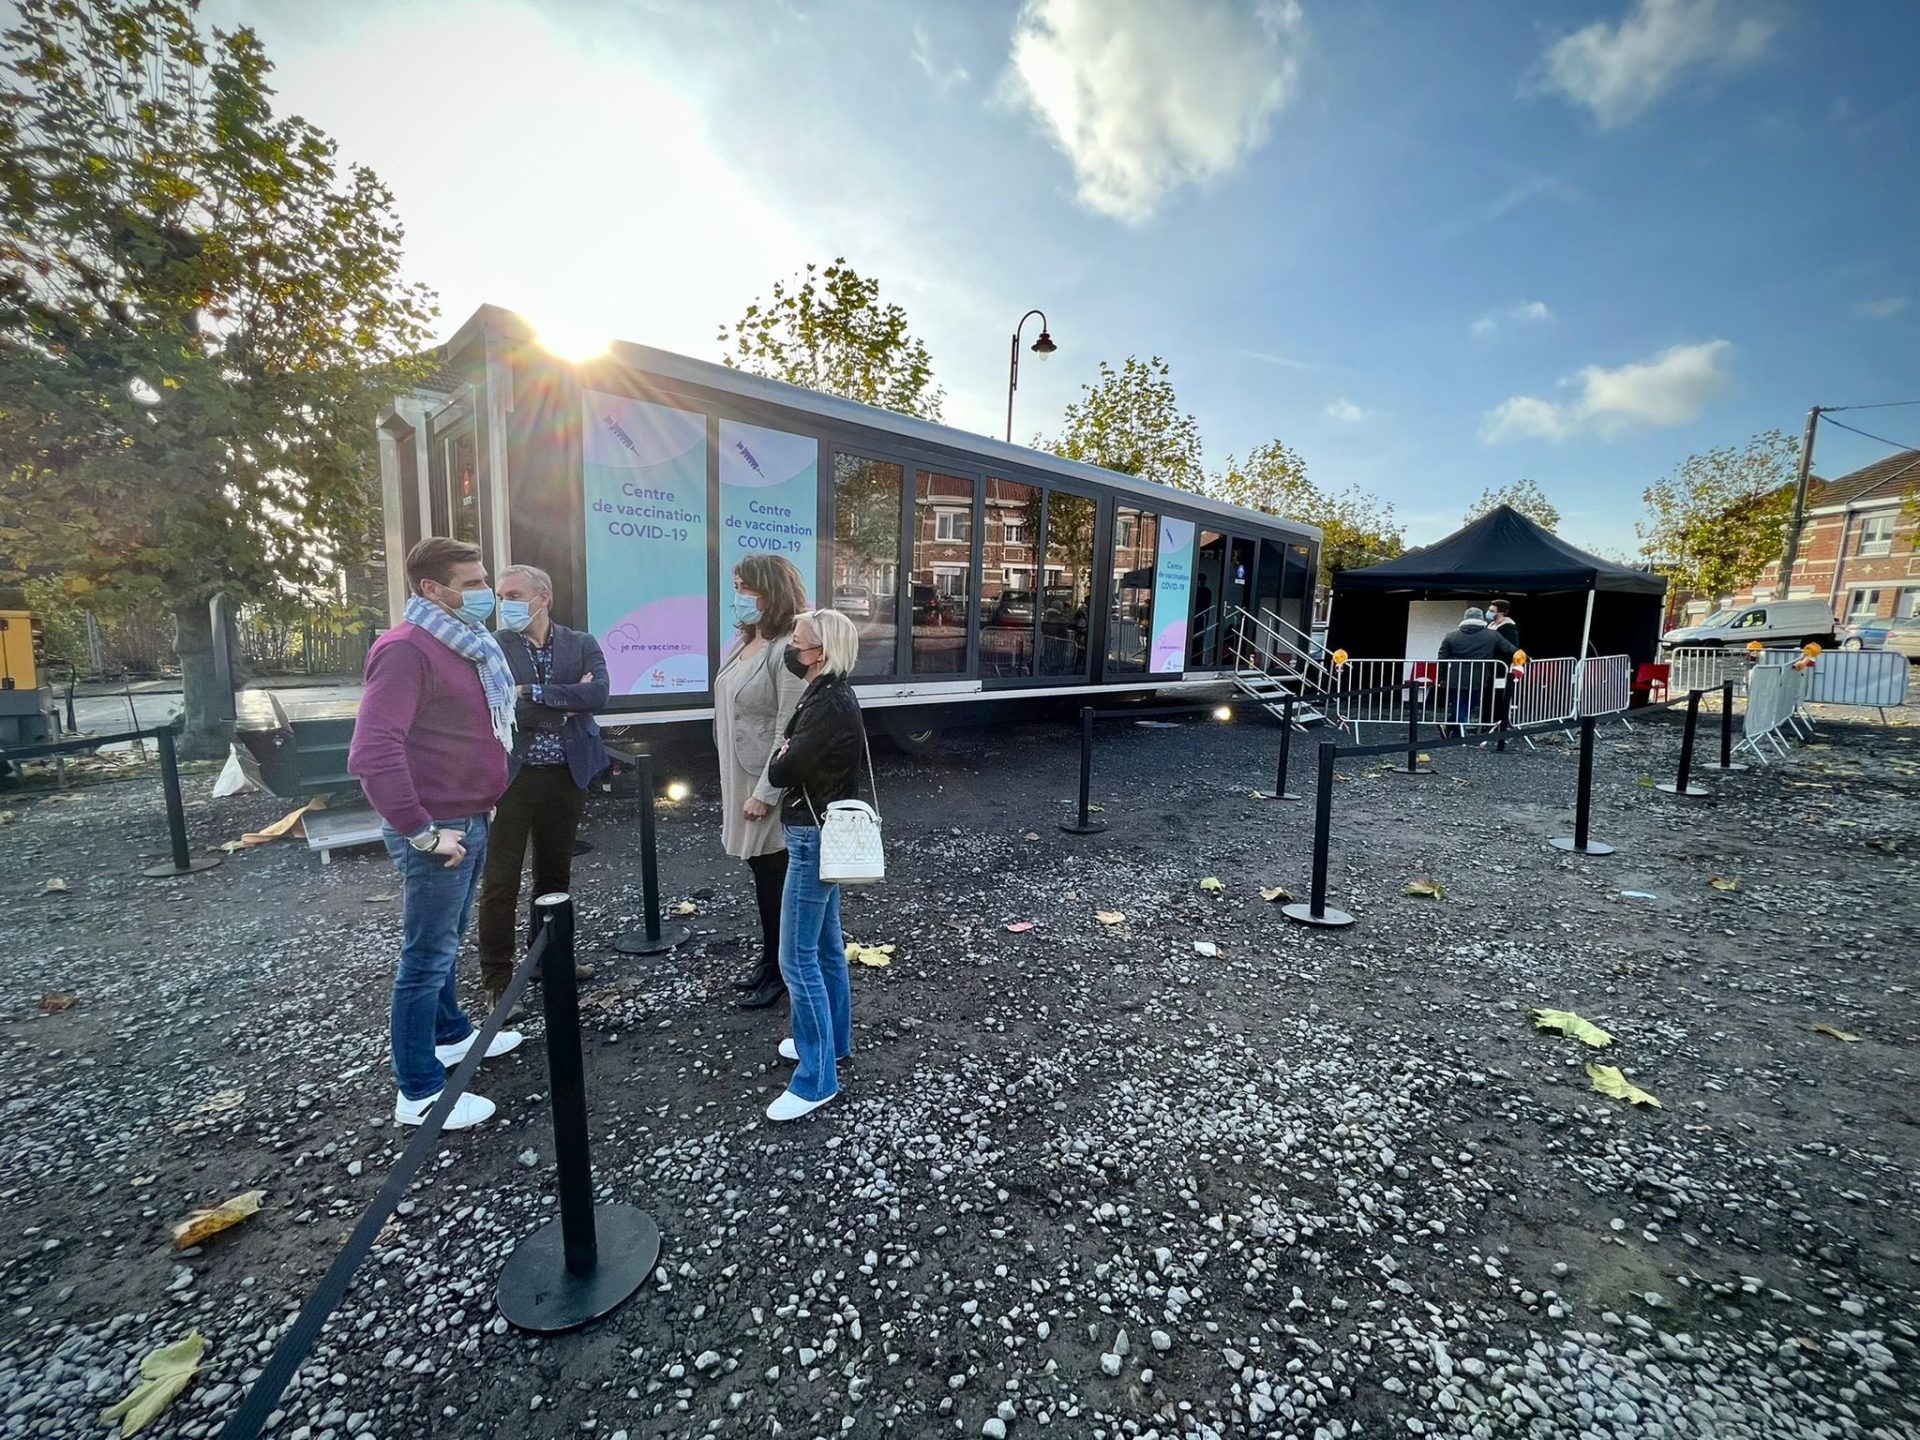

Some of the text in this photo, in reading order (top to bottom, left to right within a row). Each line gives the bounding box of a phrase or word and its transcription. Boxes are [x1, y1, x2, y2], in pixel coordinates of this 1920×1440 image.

[622, 482, 675, 502] Centre
[592, 498, 701, 523] de vaccination
[749, 500, 791, 517] Centre
[608, 521, 688, 542] COVID-19
[725, 515, 812, 536] de vaccination
[737, 535, 801, 552] COVID-19
[631, 643, 646, 651] me
